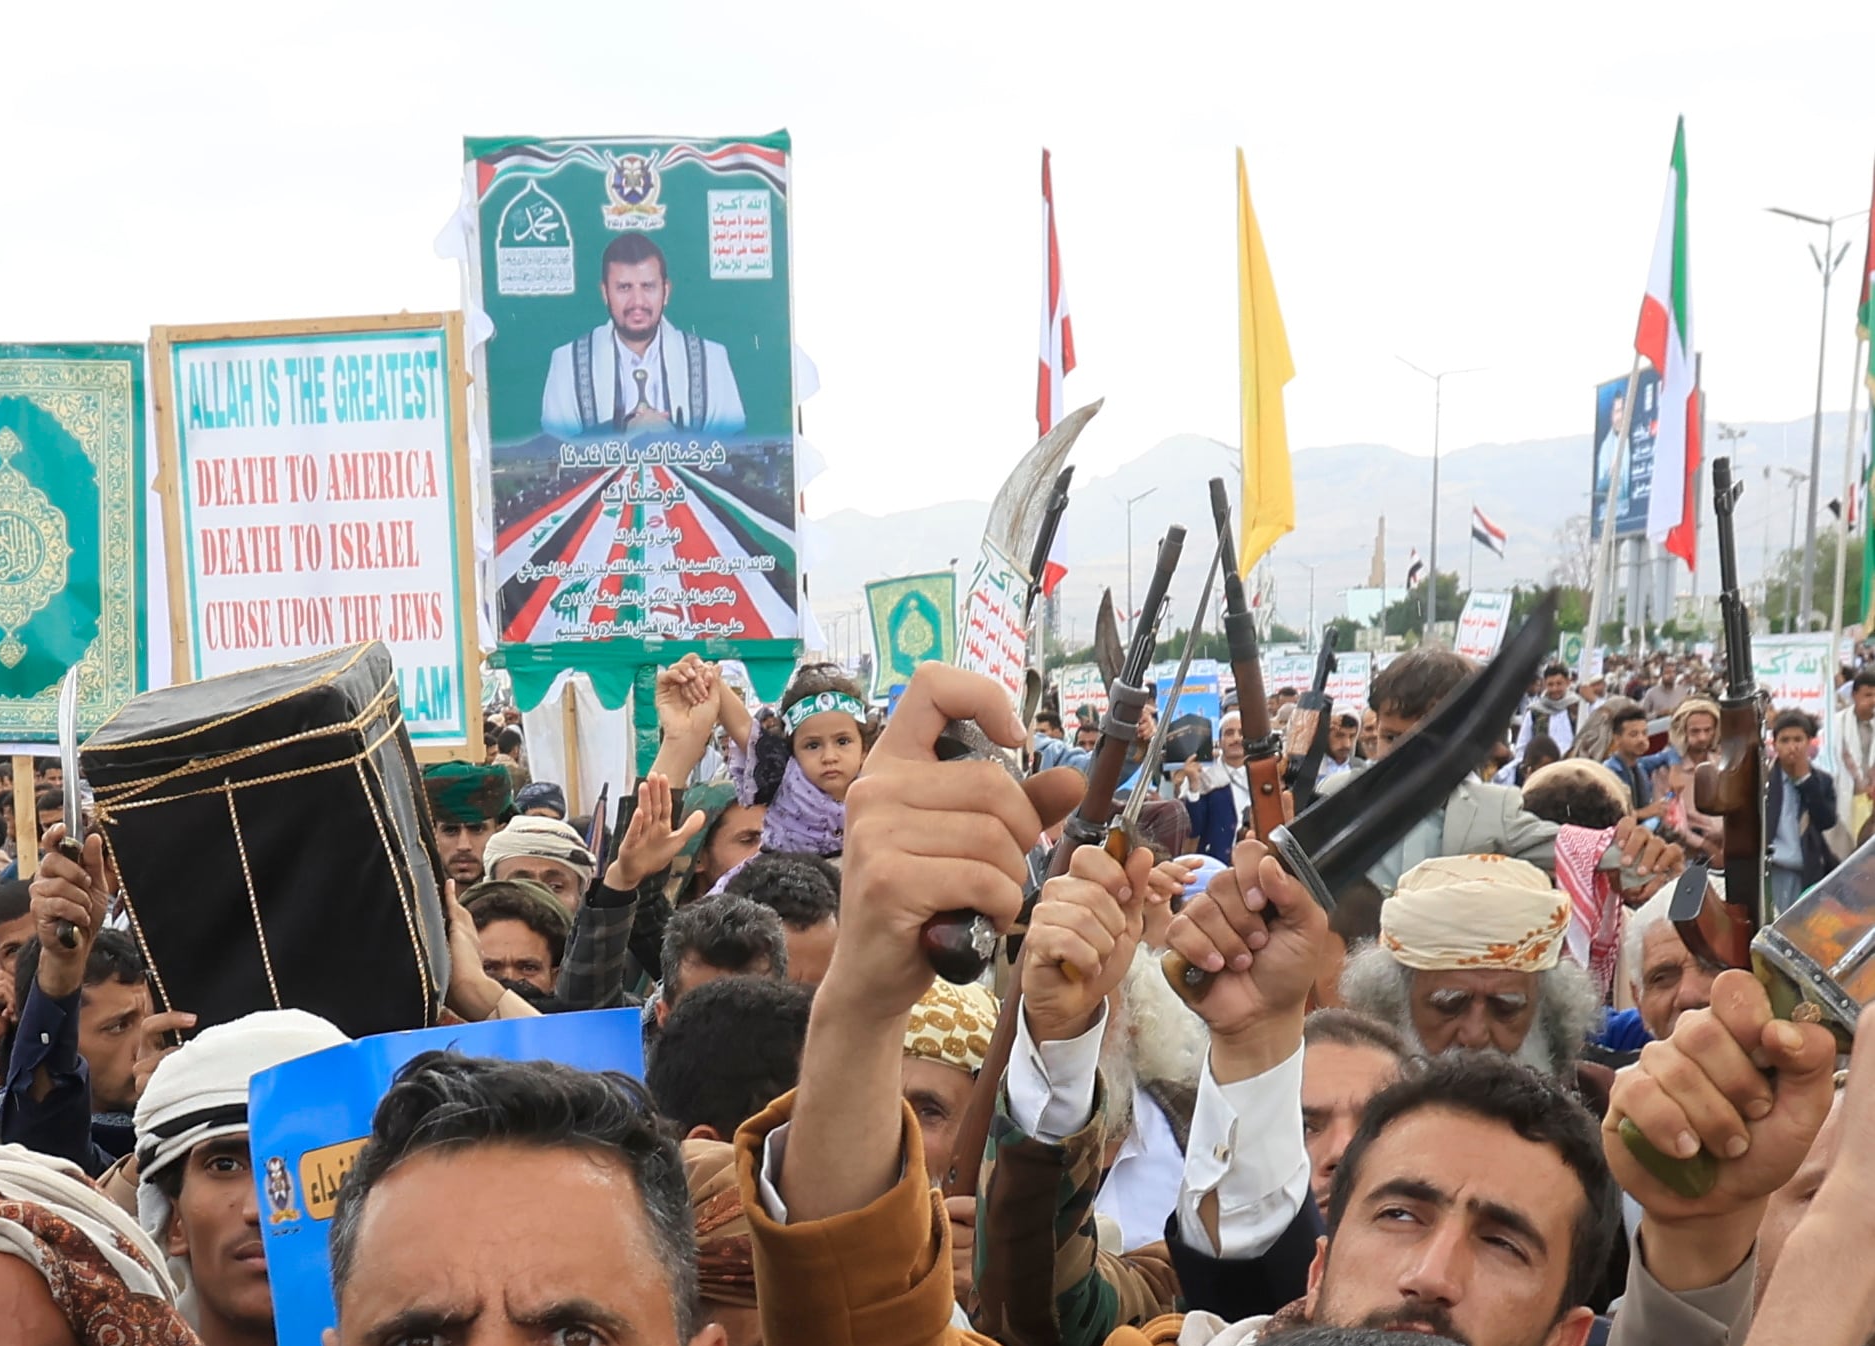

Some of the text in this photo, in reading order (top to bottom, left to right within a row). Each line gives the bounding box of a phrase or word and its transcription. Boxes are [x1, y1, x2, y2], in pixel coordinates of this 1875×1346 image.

[747, 197, 768, 209] الله
[189, 350, 438, 430] ALLAH IS THE GREATEST
[195, 449, 438, 507] DEATH TO AMERICA
[601, 481, 687, 509] فوضناك
[201, 520, 420, 576] DEATH TO ISRAEL
[205, 591, 444, 651] CURSE UPON THE JEWS
[397, 666, 452, 721] LAM
